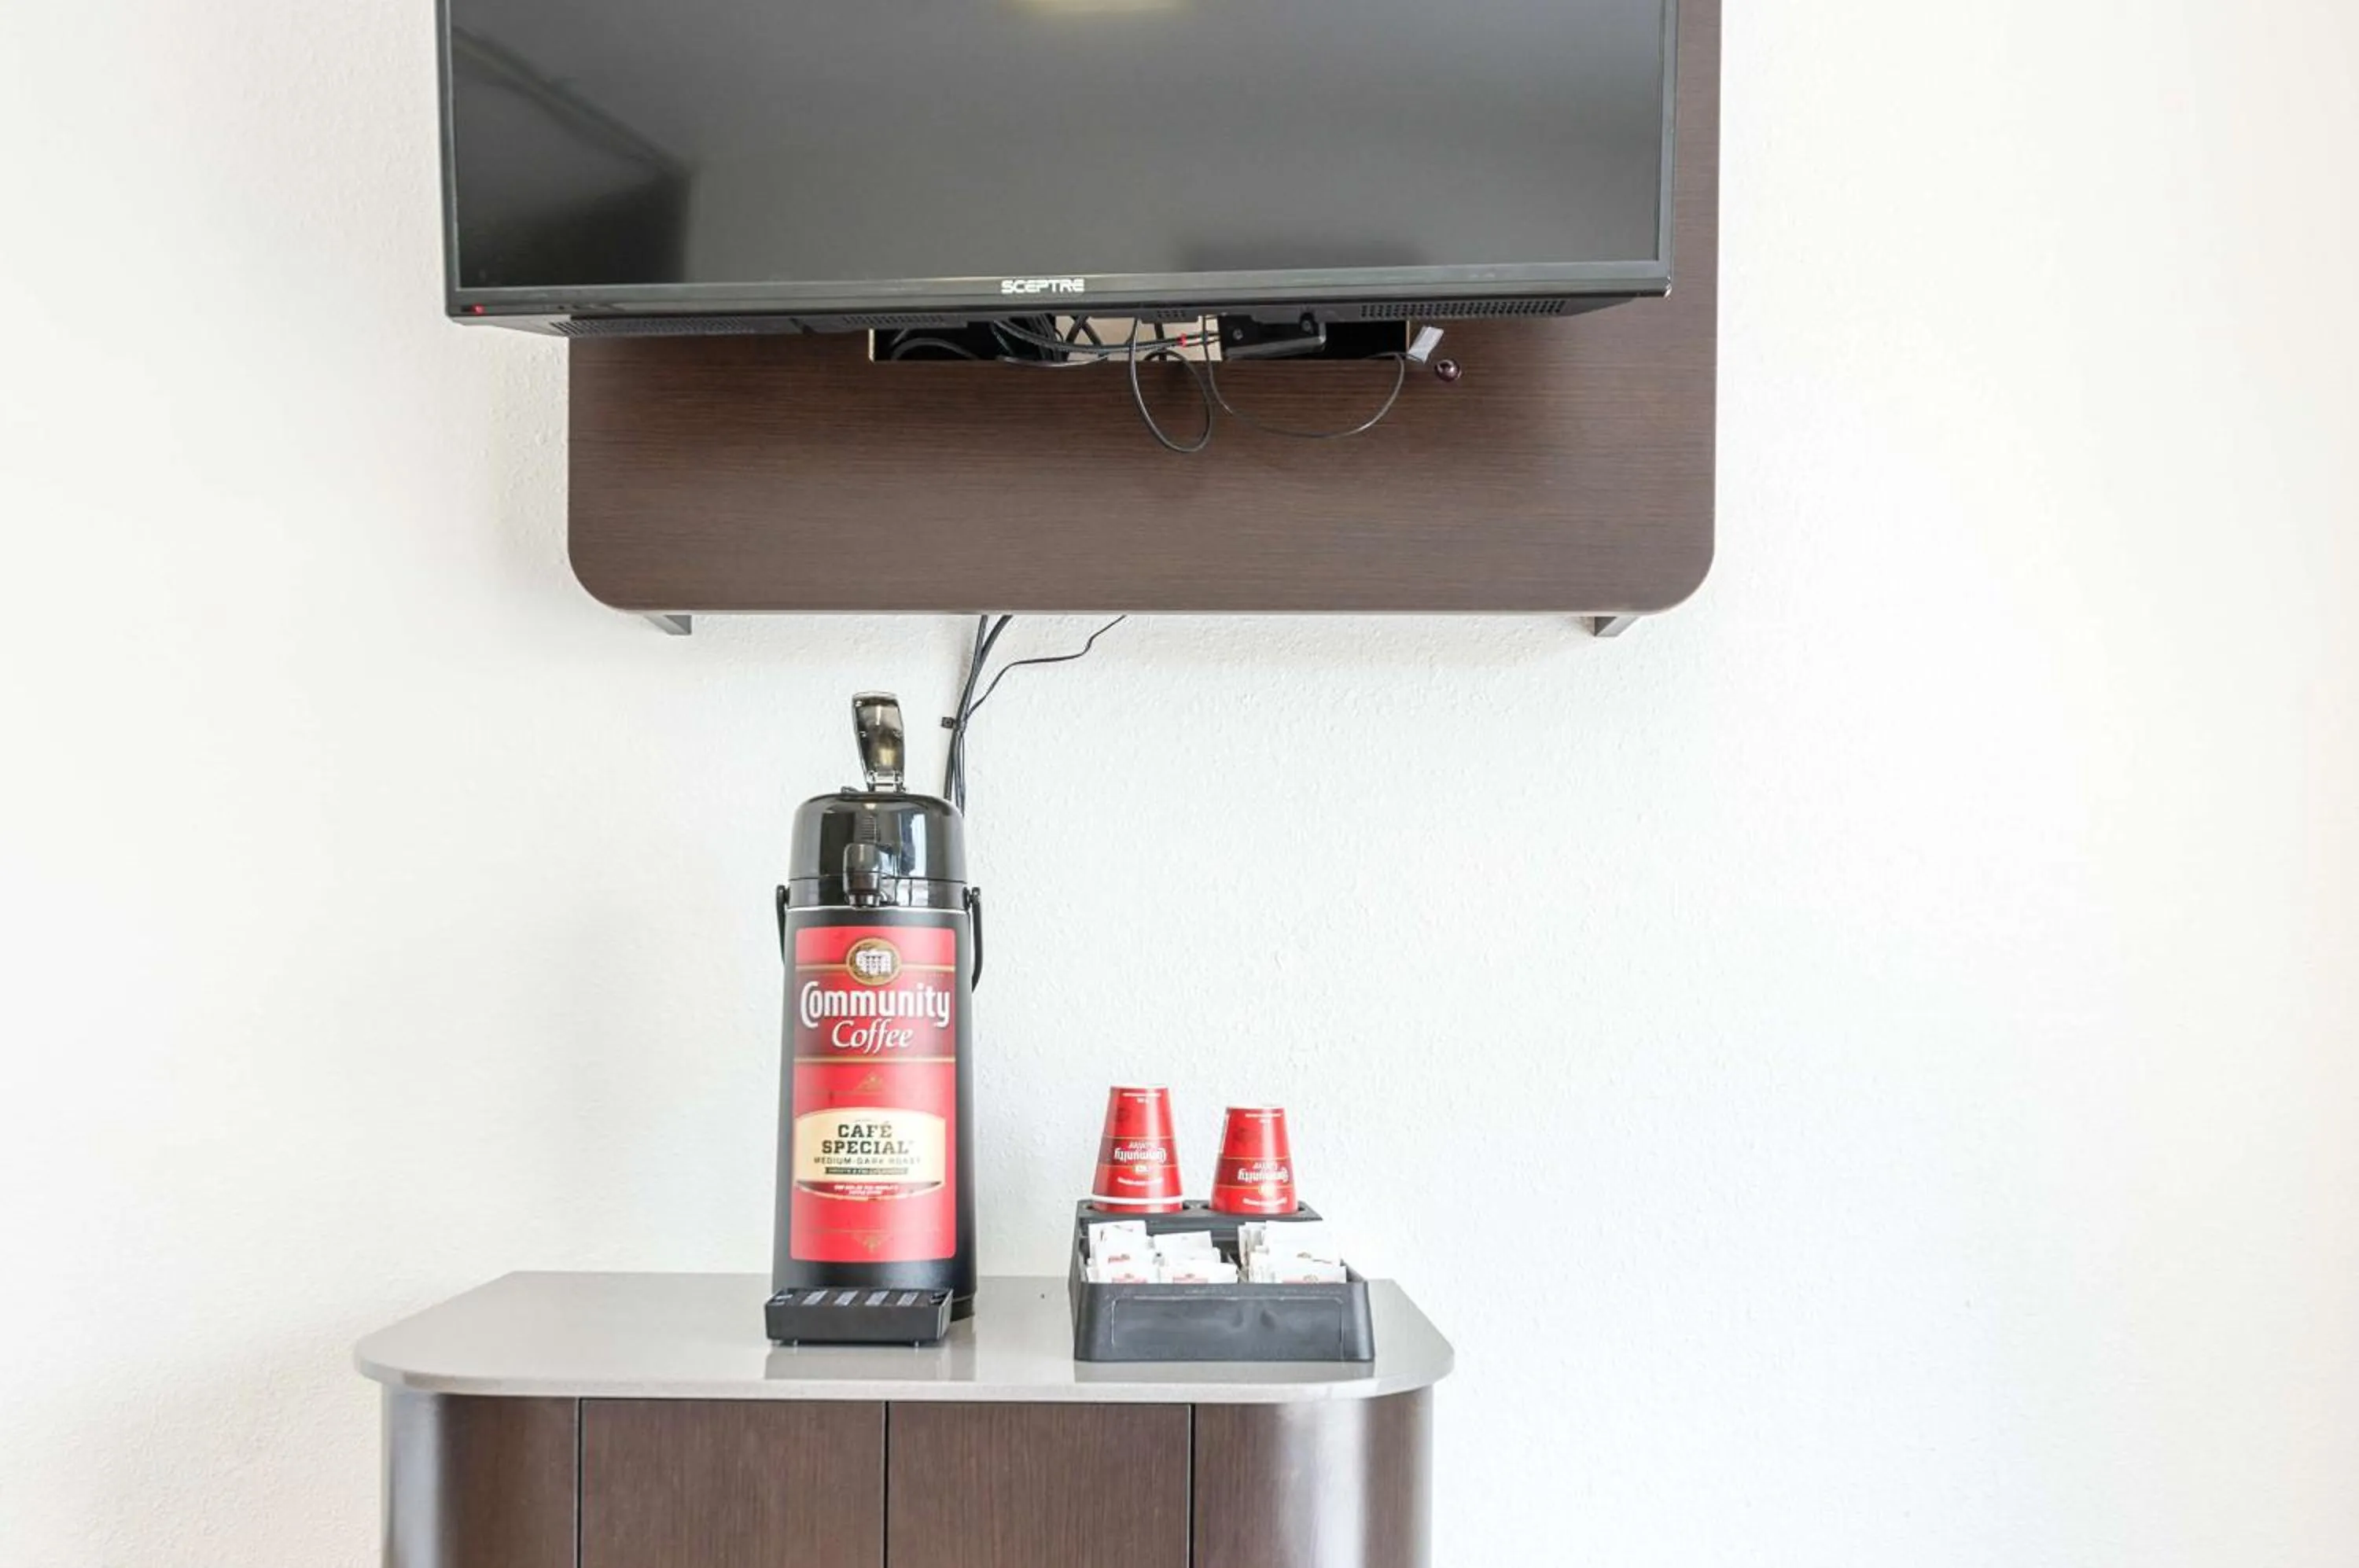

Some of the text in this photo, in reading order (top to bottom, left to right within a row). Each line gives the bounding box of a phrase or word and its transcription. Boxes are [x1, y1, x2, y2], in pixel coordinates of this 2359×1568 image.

[1001, 278, 1085, 294] SCEPTRE
[800, 981, 950, 1028] Community
[832, 1019, 914, 1054] Coffee
[837, 1121, 892, 1138] CAFÉ
[822, 1140, 909, 1154] SPECIAL
